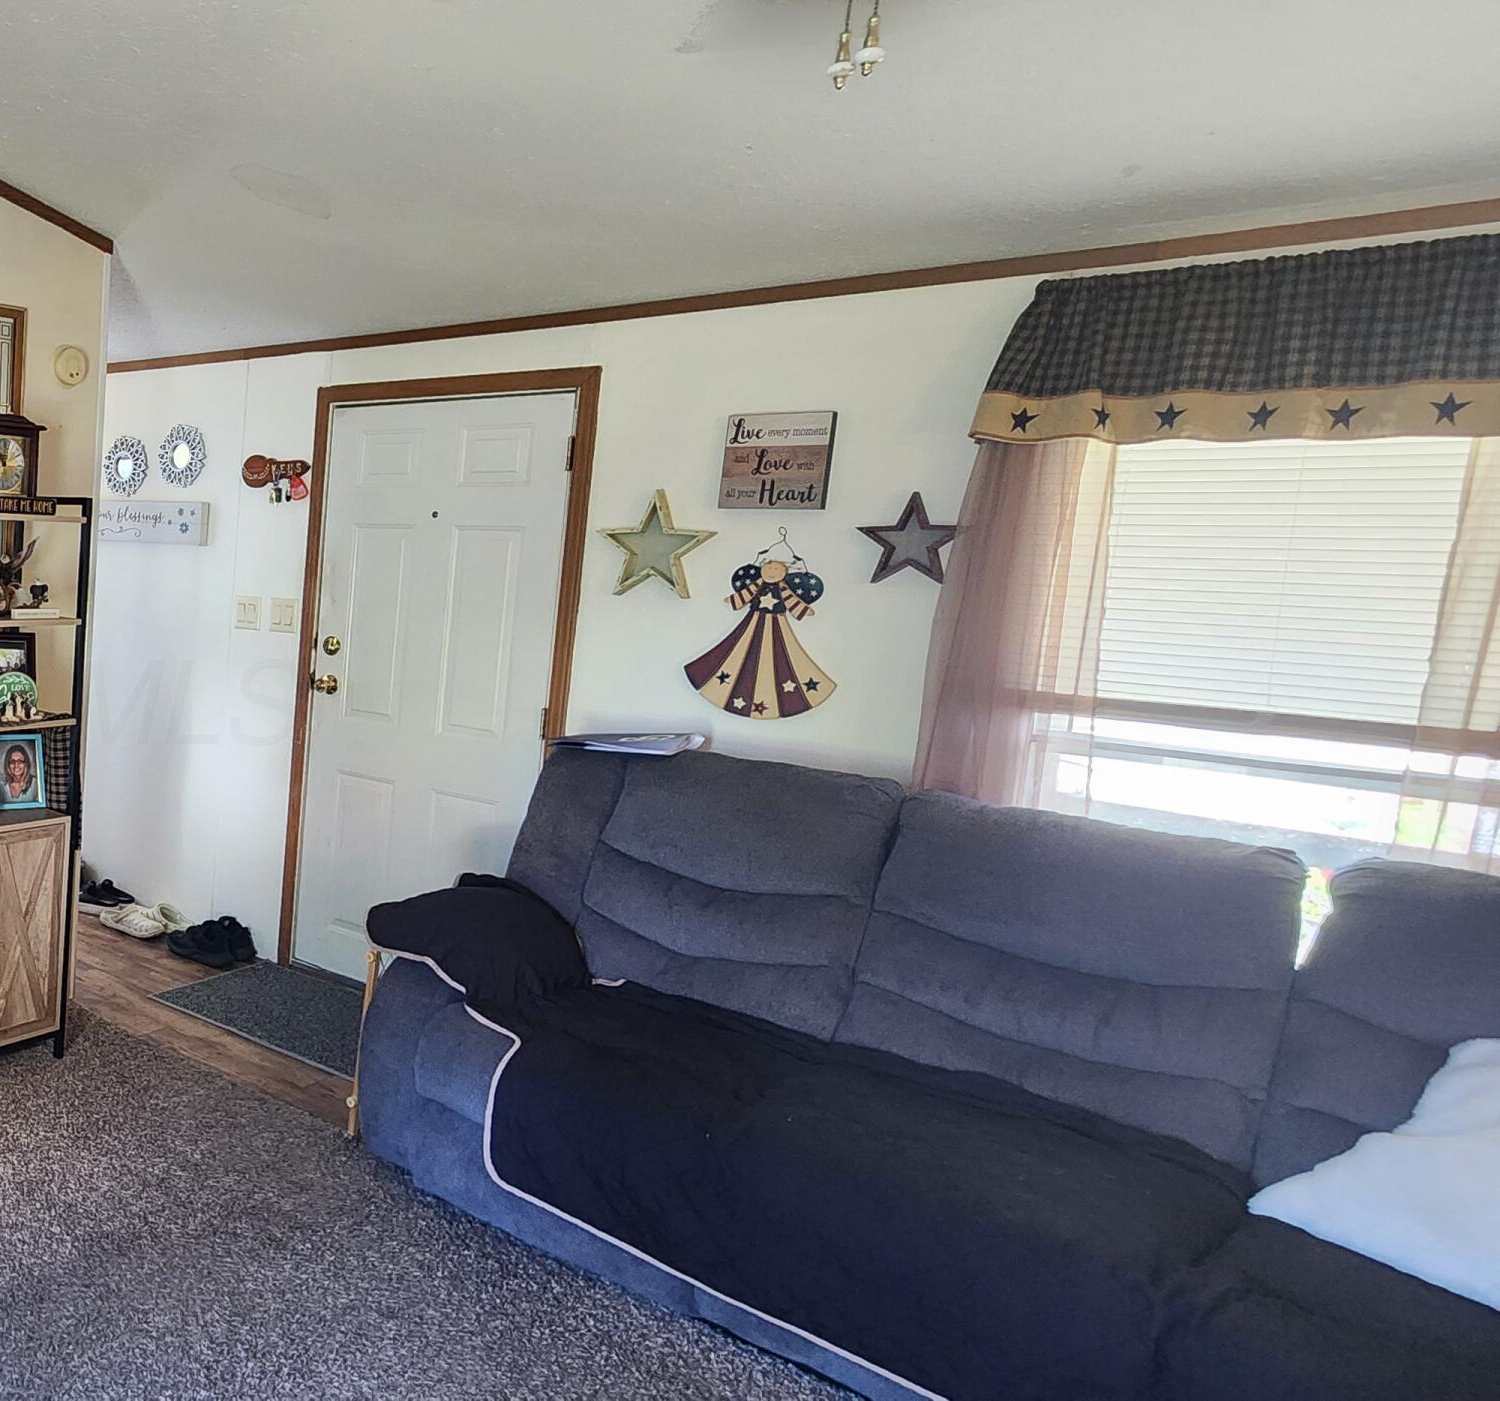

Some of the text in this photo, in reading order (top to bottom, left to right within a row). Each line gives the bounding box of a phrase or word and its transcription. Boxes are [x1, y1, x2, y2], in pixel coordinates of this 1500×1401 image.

[729, 418, 828, 444] Live every moment
[734, 448, 815, 476] and Love with
[725, 478, 818, 506] all your Heart
[0, 498, 19, 513] TAKE
[20, 499, 32, 513] ME
[33, 500, 54, 514] HOME
